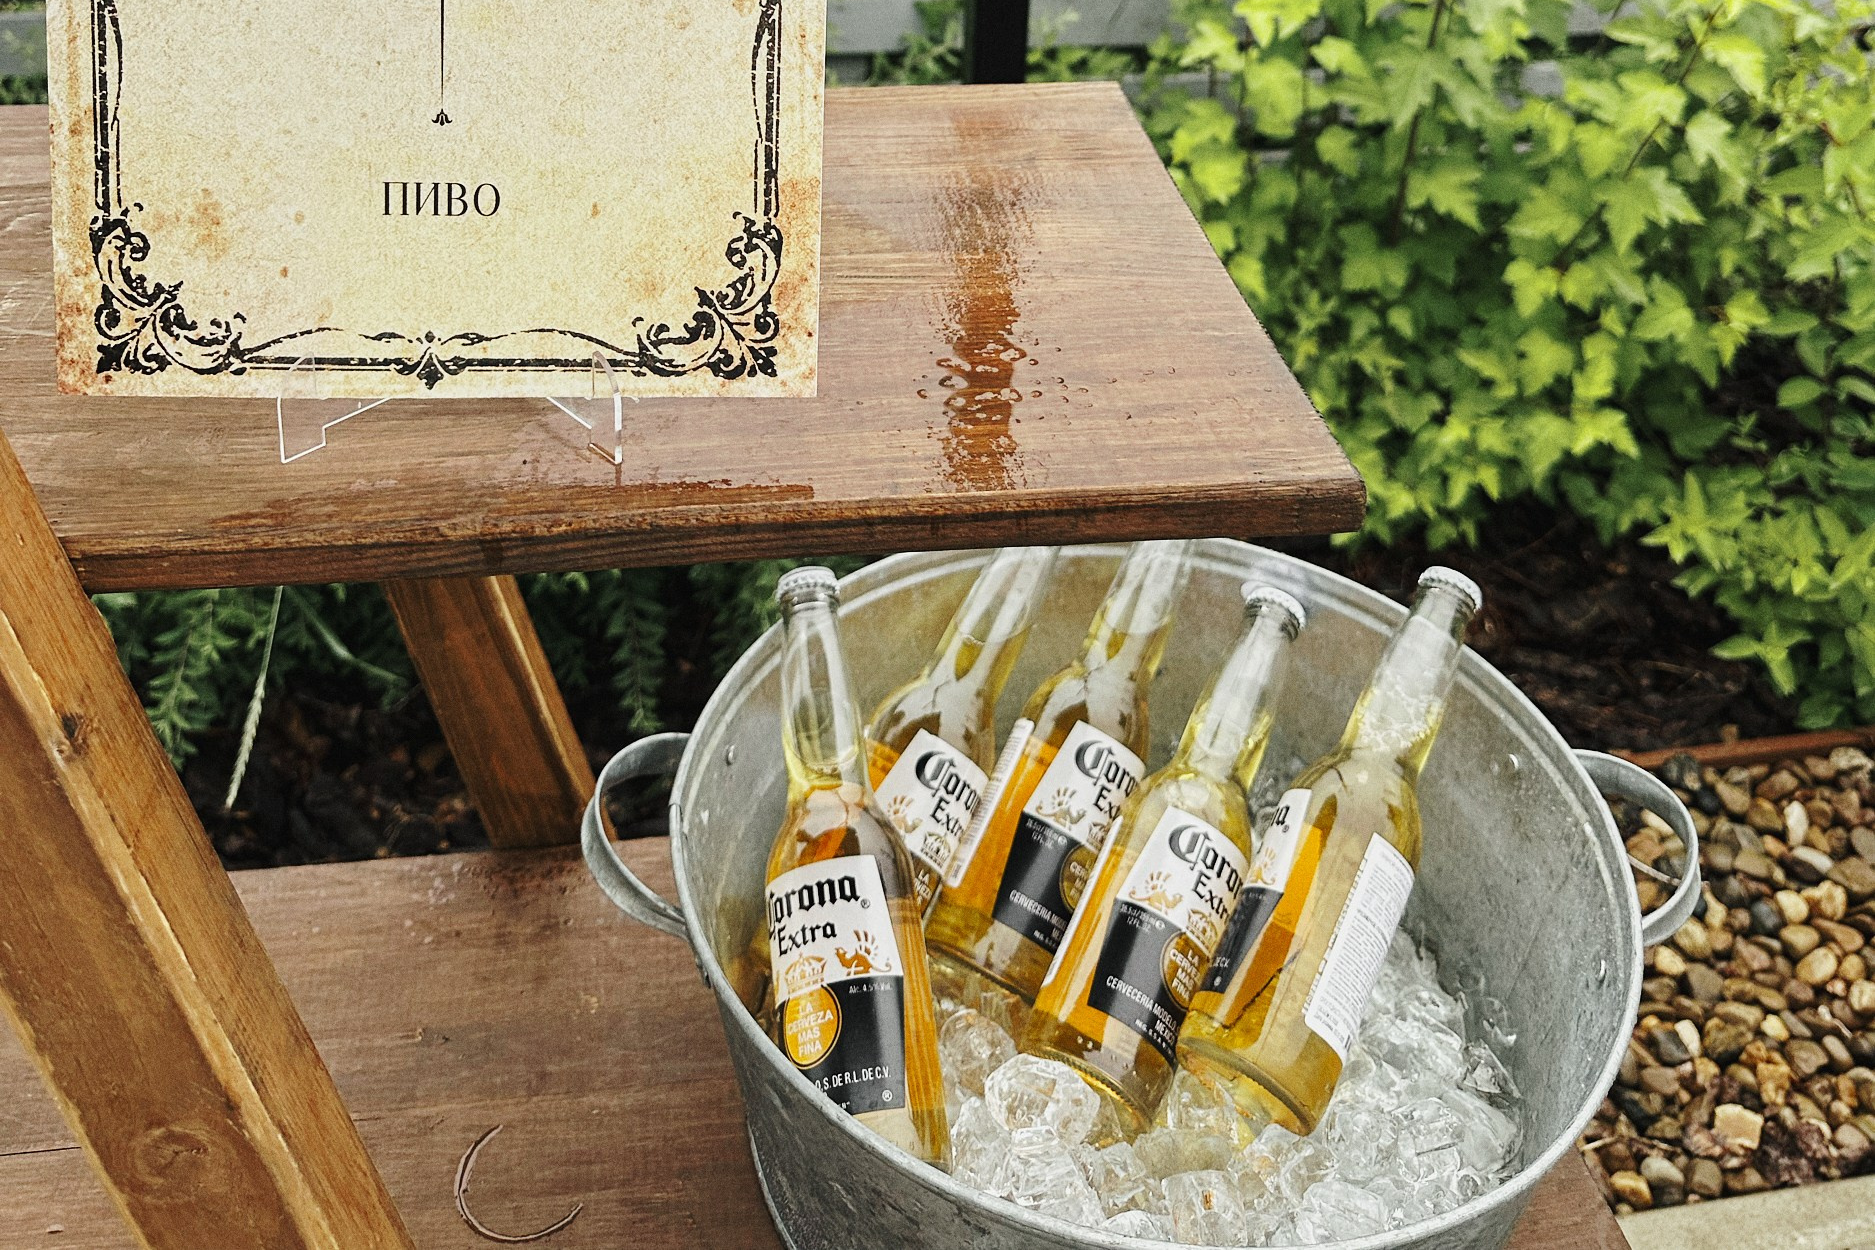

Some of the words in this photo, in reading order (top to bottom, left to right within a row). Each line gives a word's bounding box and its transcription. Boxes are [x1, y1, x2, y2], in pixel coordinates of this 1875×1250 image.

[382, 181, 501, 217] ПИВО
[930, 796, 965, 837] Extr
[777, 922, 837, 957] Extra
[1187, 950, 1200, 966] LA
[1106, 975, 1154, 1011] CERVECERIA
[799, 1002, 813, 1015] LA
[787, 1008, 834, 1035] CERVEZA
[798, 1026, 820, 1043] MAS
[798, 1040, 823, 1057] FINA
[831, 1075, 844, 1088] DE
[844, 1071, 861, 1085] R.L.
[861, 1067, 874, 1081] DE
[874, 1065, 892, 1080] C.V.
